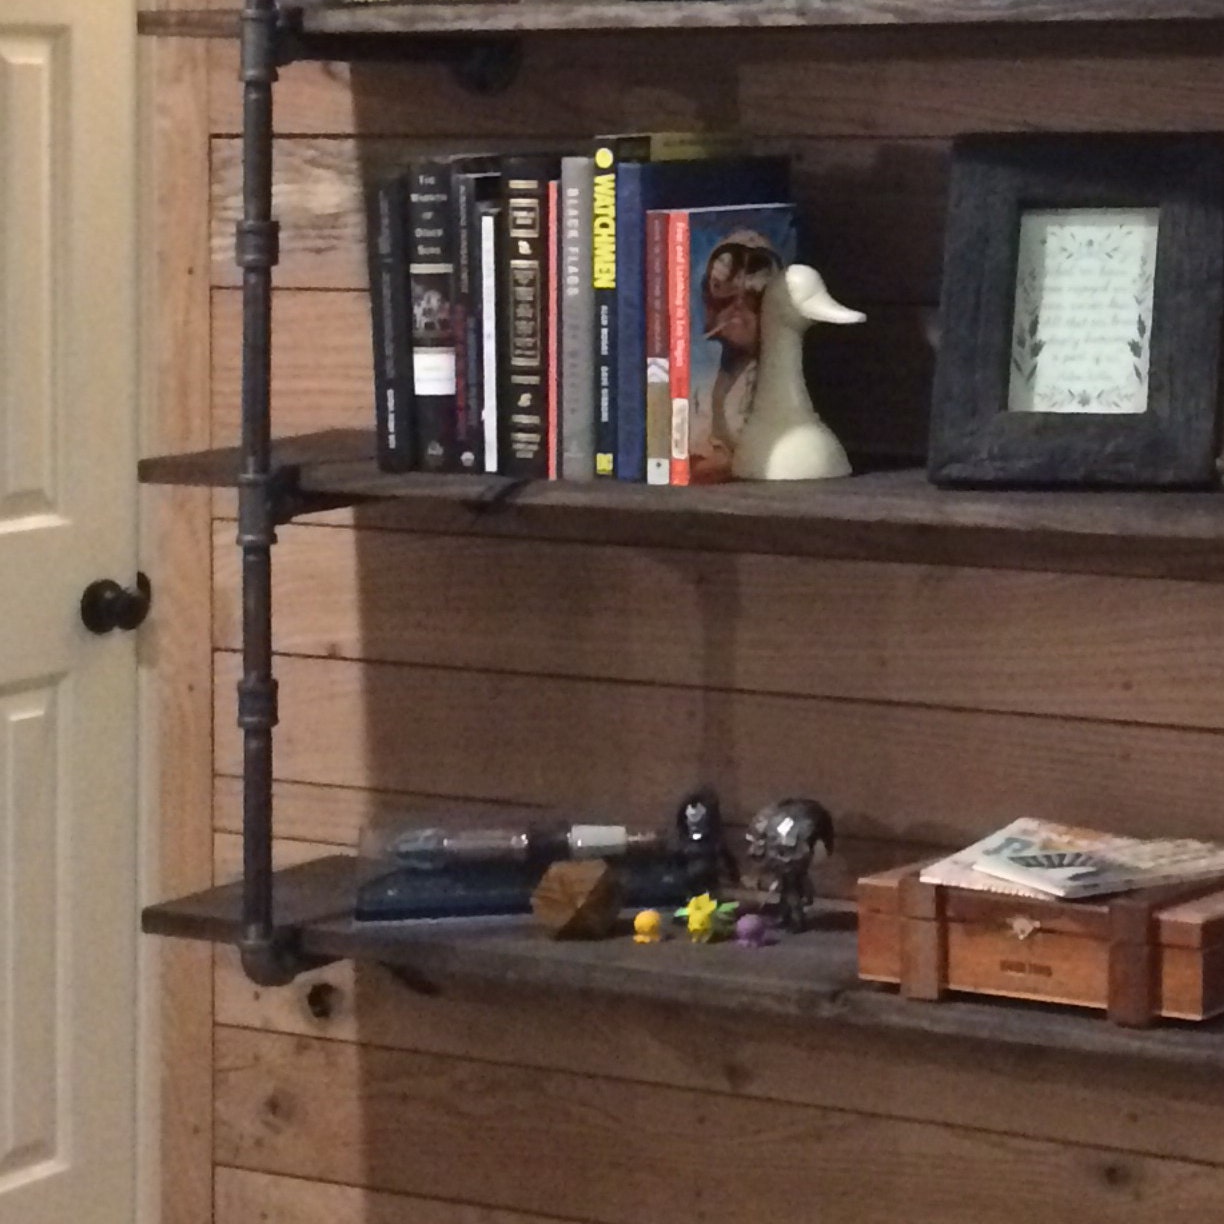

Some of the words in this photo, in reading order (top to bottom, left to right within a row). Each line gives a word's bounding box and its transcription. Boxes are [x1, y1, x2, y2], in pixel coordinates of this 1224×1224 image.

[567, 187, 579, 239] BLACK
[594, 173, 616, 289] WATCHMEN
[567, 246, 579, 297] FLAGS
